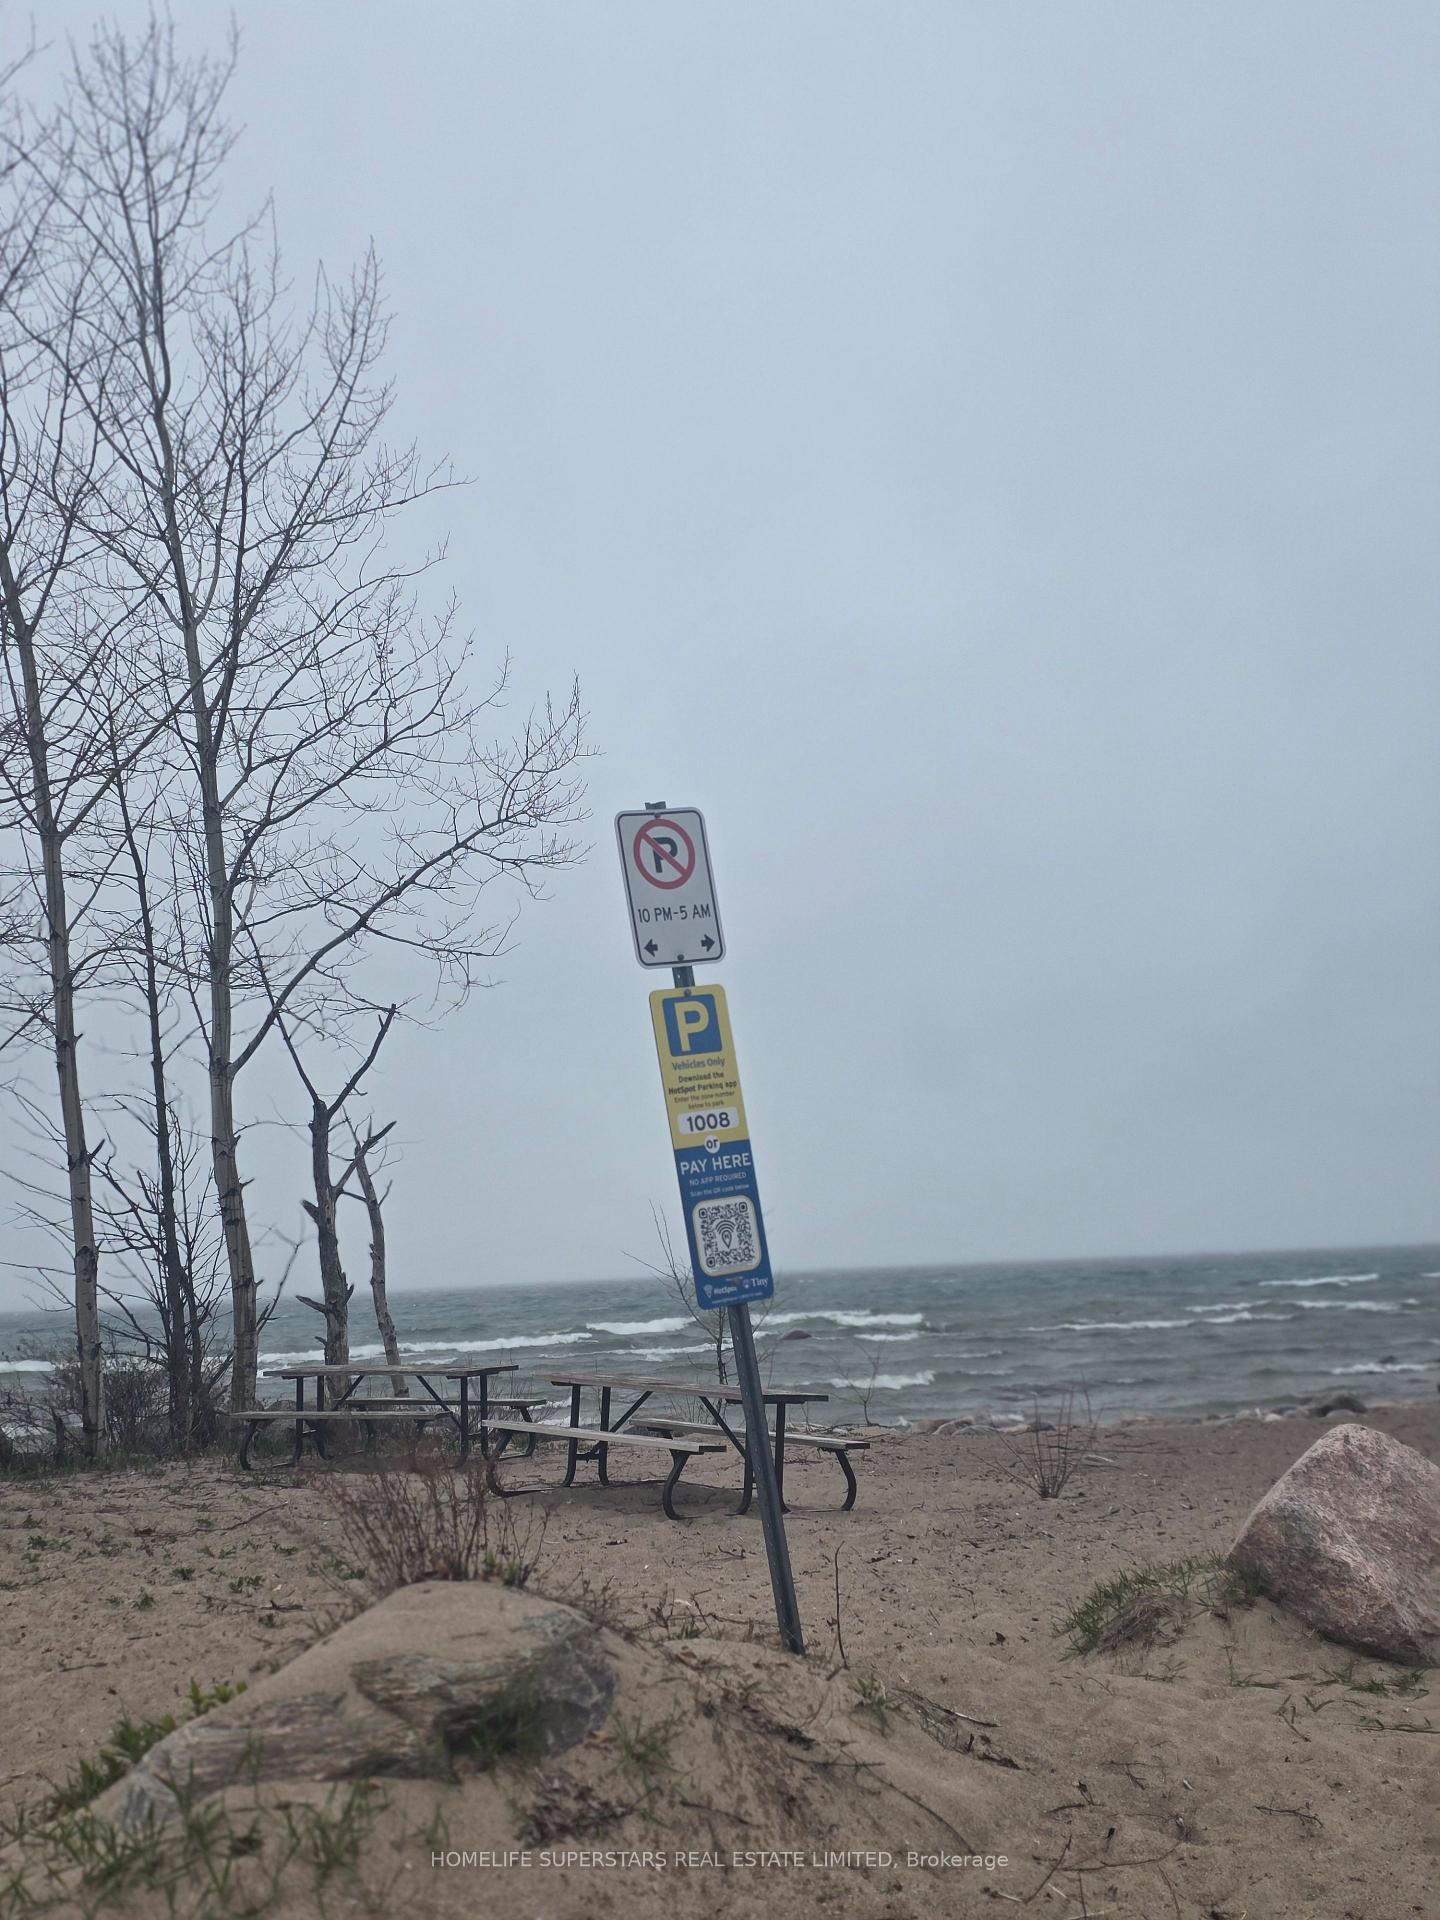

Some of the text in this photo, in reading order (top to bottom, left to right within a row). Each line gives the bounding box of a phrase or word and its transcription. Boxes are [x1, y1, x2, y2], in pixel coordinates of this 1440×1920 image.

[638, 904, 711, 923] 10 PM-5 AM
[674, 1001, 709, 1052] P
[672, 1057, 725, 1070] Vehicles Only
[678, 1073, 711, 1083] Download
[669, 1085, 696, 1095] HotSpot
[698, 1082, 723, 1091] Parking
[686, 1112, 730, 1132] 1008
[706, 1139, 718, 1149] or
[680, 1153, 751, 1175] PAY HERE
[700, 1176, 714, 1184] APP
[715, 1172, 746, 1182] REQUIRED
[751, 1277, 768, 1287] Tiny
